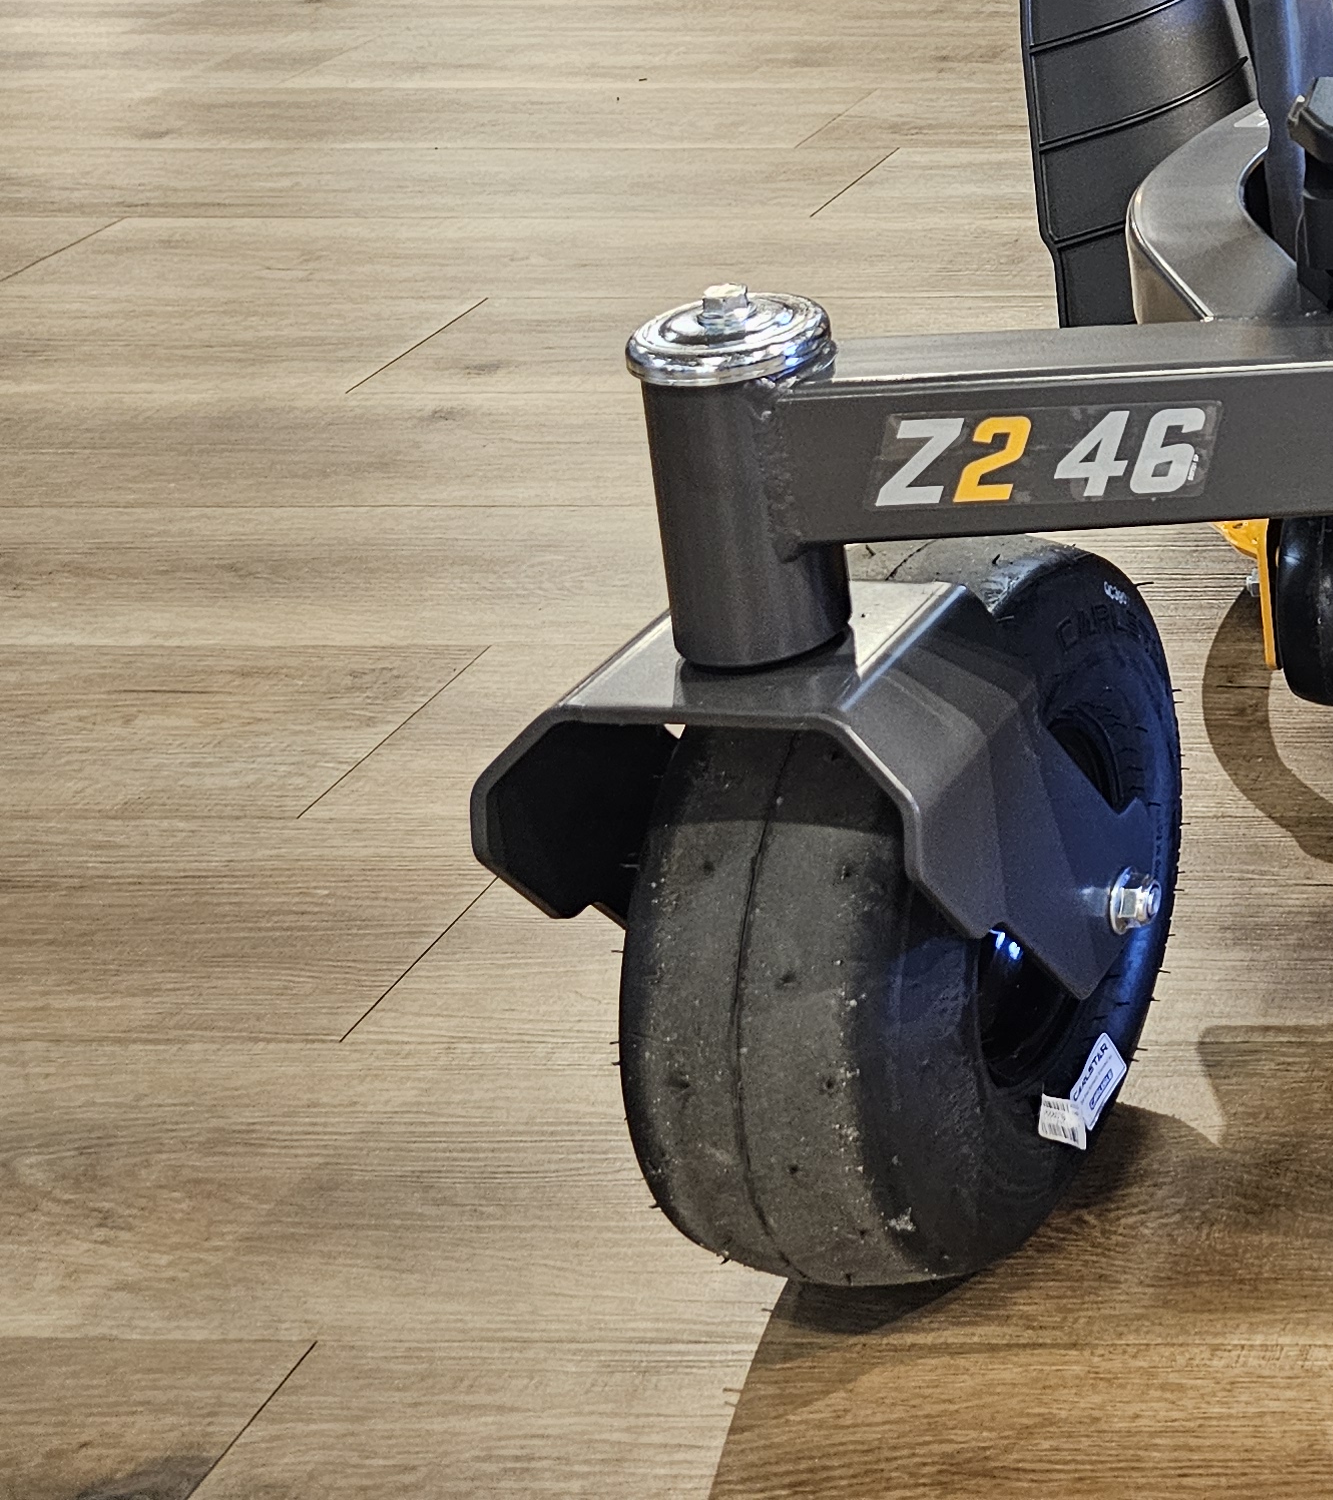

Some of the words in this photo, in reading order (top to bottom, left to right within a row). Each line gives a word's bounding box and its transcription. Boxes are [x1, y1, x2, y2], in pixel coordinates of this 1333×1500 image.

[875, 415, 1032, 506] Z2
[1053, 407, 1207, 497] 46
[1073, 1042, 1109, 1102] CARLSTAR
